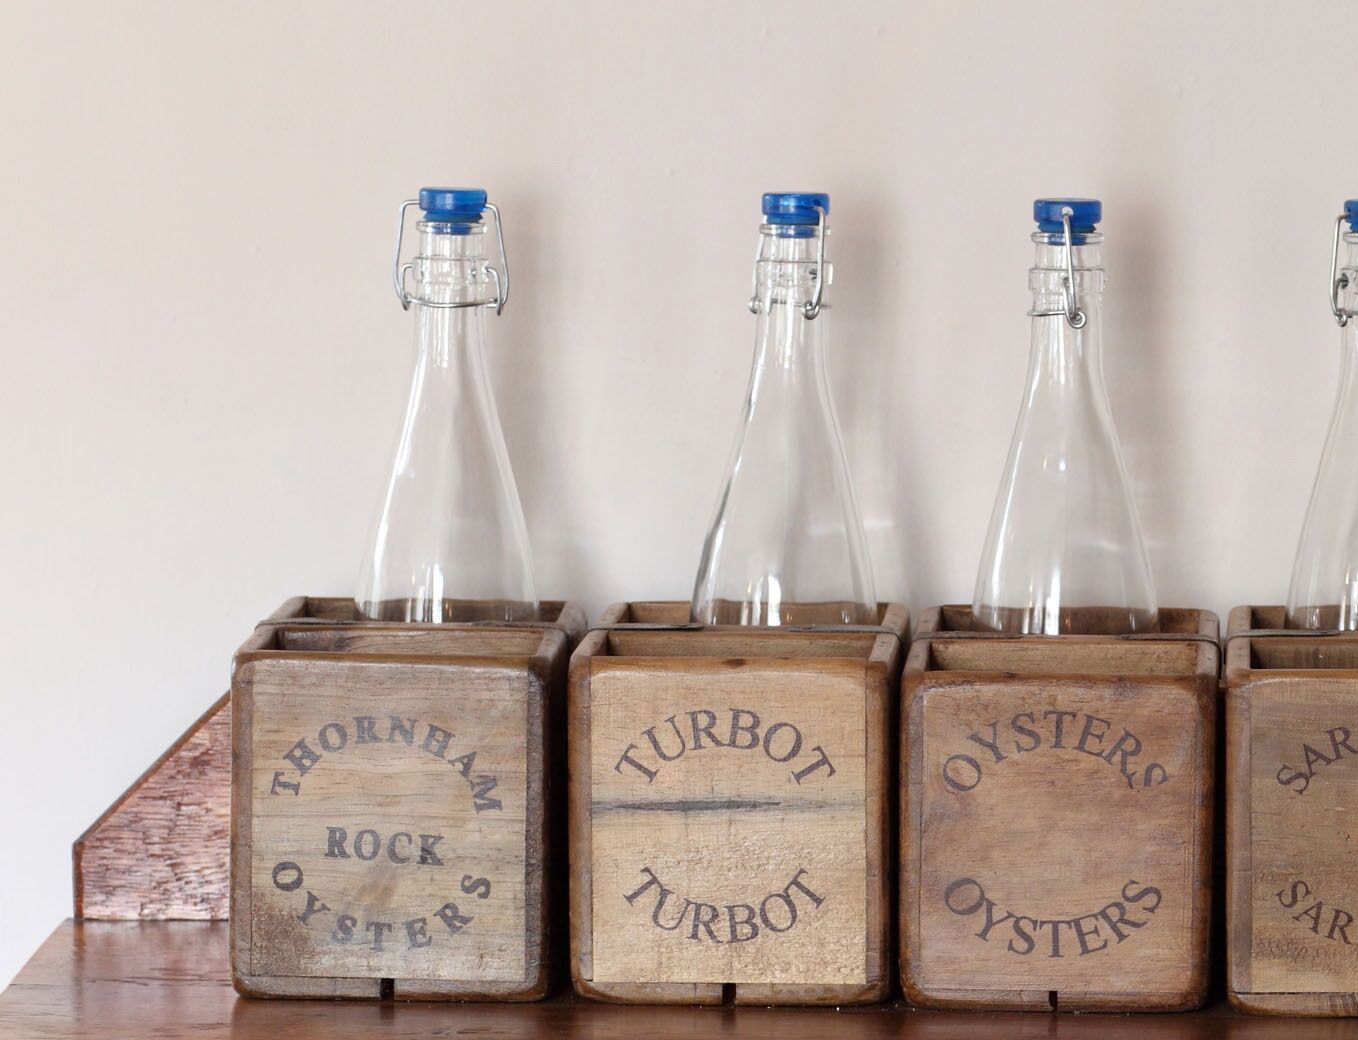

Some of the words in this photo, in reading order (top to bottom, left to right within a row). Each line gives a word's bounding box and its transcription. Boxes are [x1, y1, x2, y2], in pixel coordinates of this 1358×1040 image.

[271, 714, 504, 815] THORNHAM
[613, 707, 836, 785] TURBOT
[942, 710, 1169, 793] OYSTERS
[324, 826, 446, 866] ROCK
[272, 860, 492, 951] OYSTERS
[622, 866, 827, 945] TURBOT
[943, 876, 1163, 959] OYSTERS
